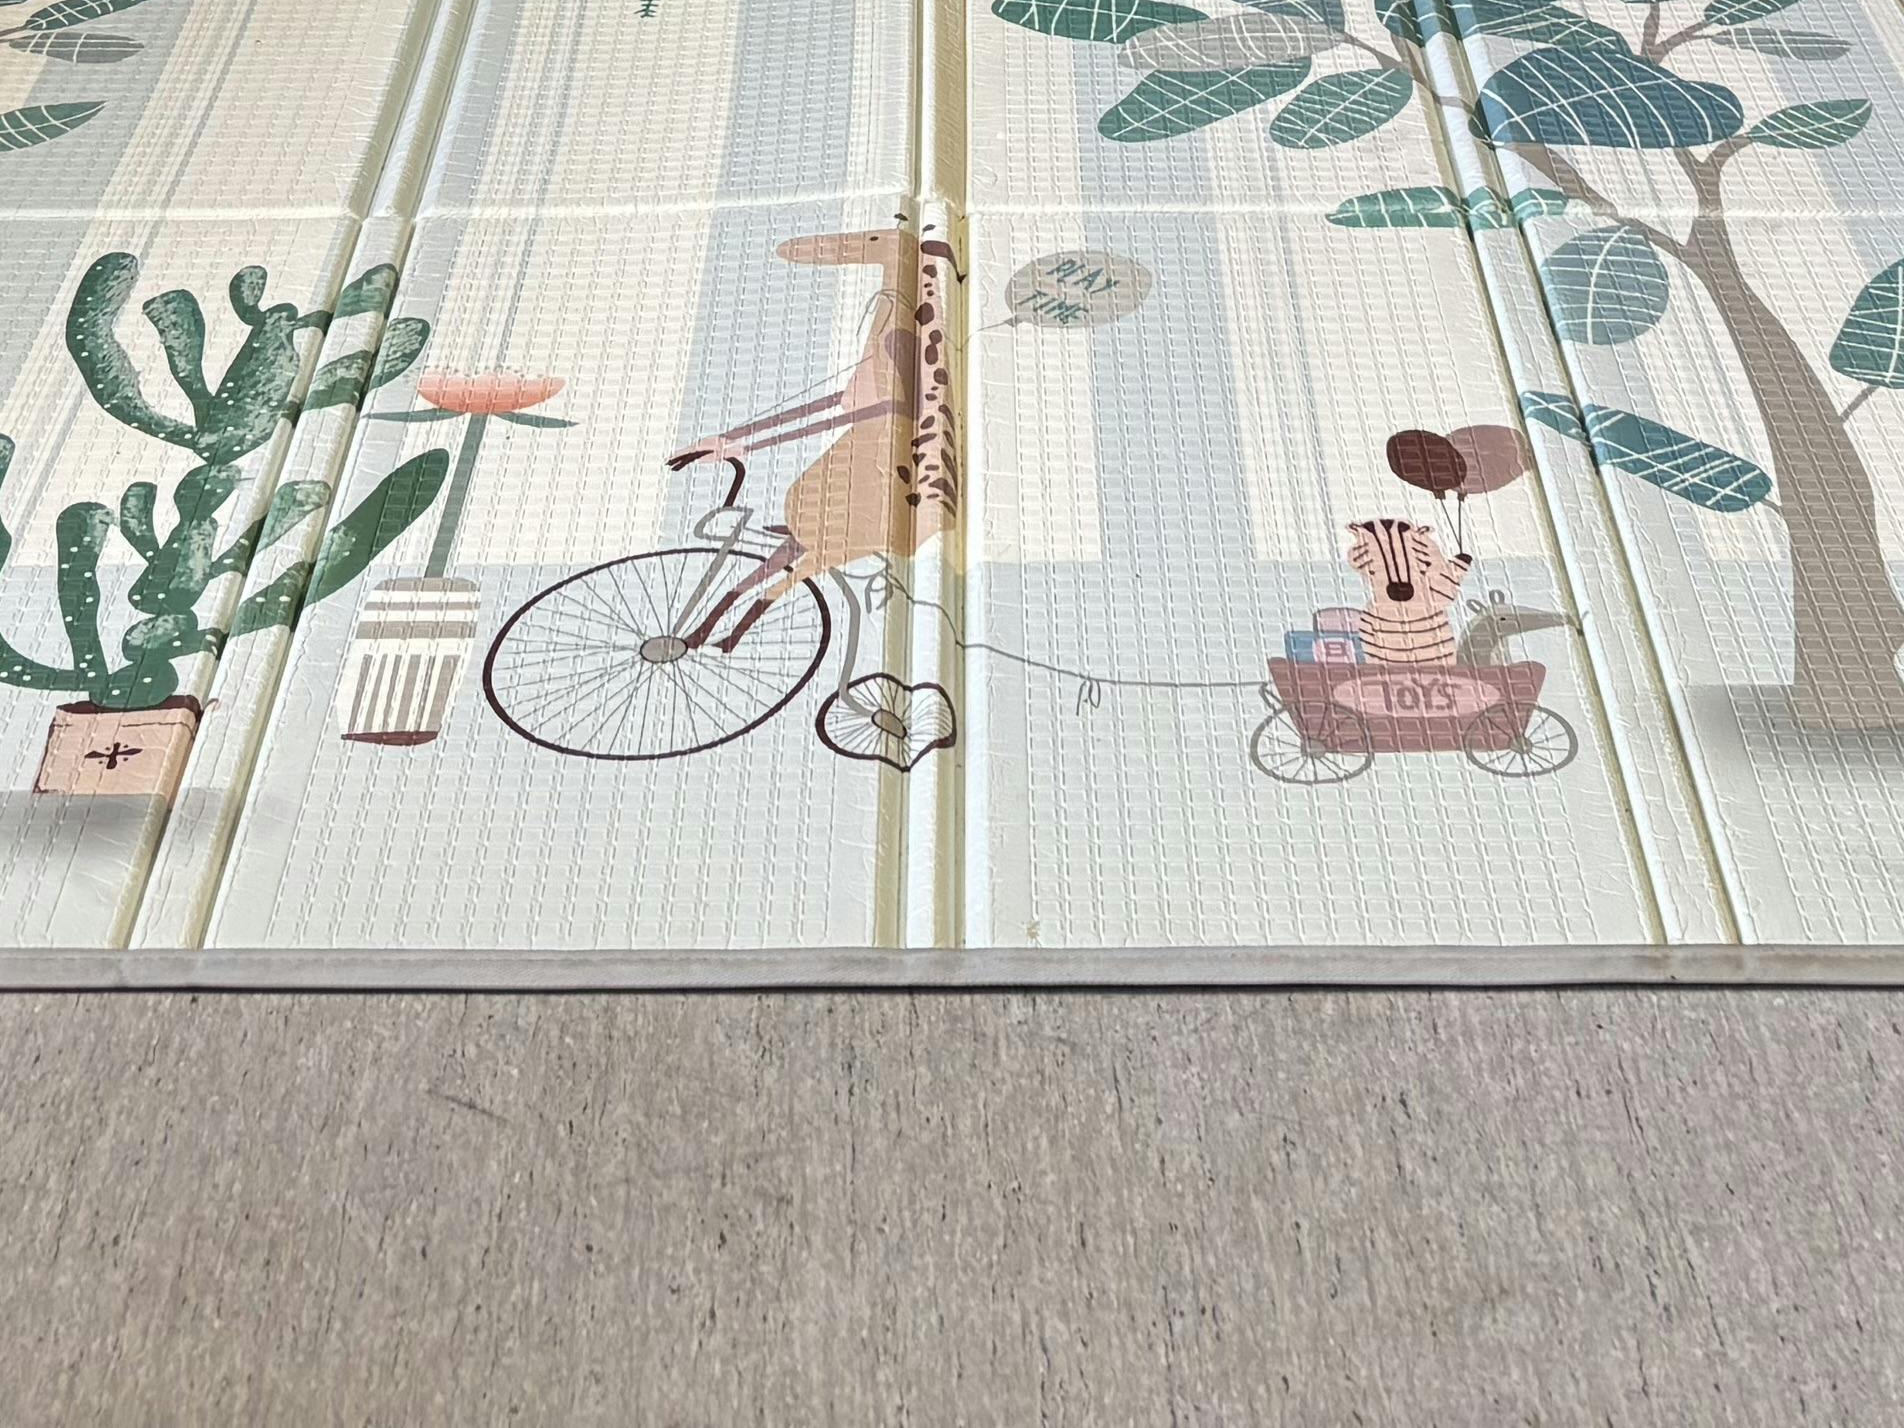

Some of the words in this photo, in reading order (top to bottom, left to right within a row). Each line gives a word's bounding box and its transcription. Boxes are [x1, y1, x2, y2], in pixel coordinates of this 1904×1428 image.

[1045, 258, 1120, 295] PLAY
[1017, 289, 1089, 325] TIME
[1362, 676, 1462, 712] TOYS
